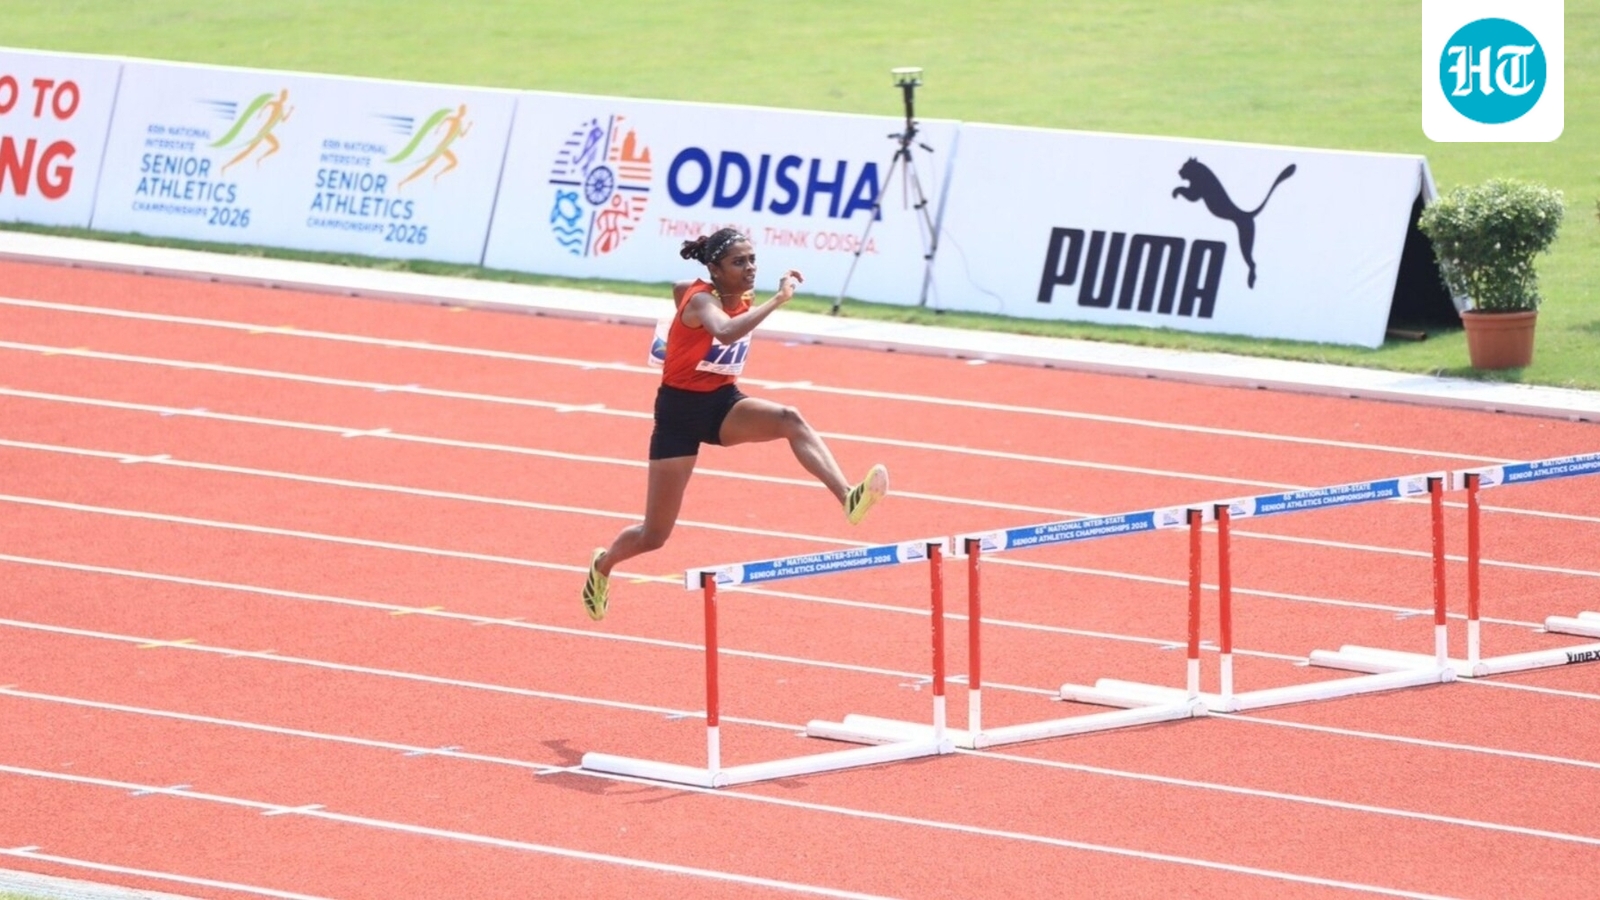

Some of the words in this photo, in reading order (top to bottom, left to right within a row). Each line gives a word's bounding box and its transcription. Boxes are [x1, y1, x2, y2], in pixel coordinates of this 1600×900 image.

[33, 78, 80, 120] TO
[140, 153, 211, 178] SENIOR
[136, 177, 237, 204] ATHLETICS
[315, 169, 387, 194] SENIOR
[667, 147, 882, 221] ODISHA
[208, 206, 250, 228] 2026
[311, 192, 414, 220] ATHLETICS
[384, 223, 428, 245] 2026
[659, 218, 705, 239] THINK
[765, 227, 810, 248] THINK
[1037, 226, 1227, 319] PUMA
[1509, 470, 1533, 480] SENIOR
[1534, 465, 1568, 477] ATHLETICS
[1261, 502, 1286, 512] SENIOR
[1287, 497, 1322, 509] ATHLETICS
[1323, 491, 1376, 504] CHAMPIONSHIPS
[1377, 488, 1393, 497] 2026
[1295, 488, 1328, 499] NATIONAL
[1328, 483, 1371, 496] INTER-STATE
[1012, 536, 1038, 546] SENIOR
[1039, 530, 1074, 542] ATHLETICS
[1075, 524, 1130, 537] CHAMPIONSHIPS
[1131, 521, 1149, 530] 2026
[1048, 521, 1082, 533] NATIONAL
[1083, 516, 1126, 528] INTER-STATE
[749, 568, 777, 580] SENIOR
[777, 563, 815, 576] ATHLETICS
[816, 557, 873, 571] CHAMPIONSHIPS
[873, 554, 891, 564] 2026
[786, 555, 822, 566] NATIONAL
[823, 550, 868, 561] INTER-STATE
